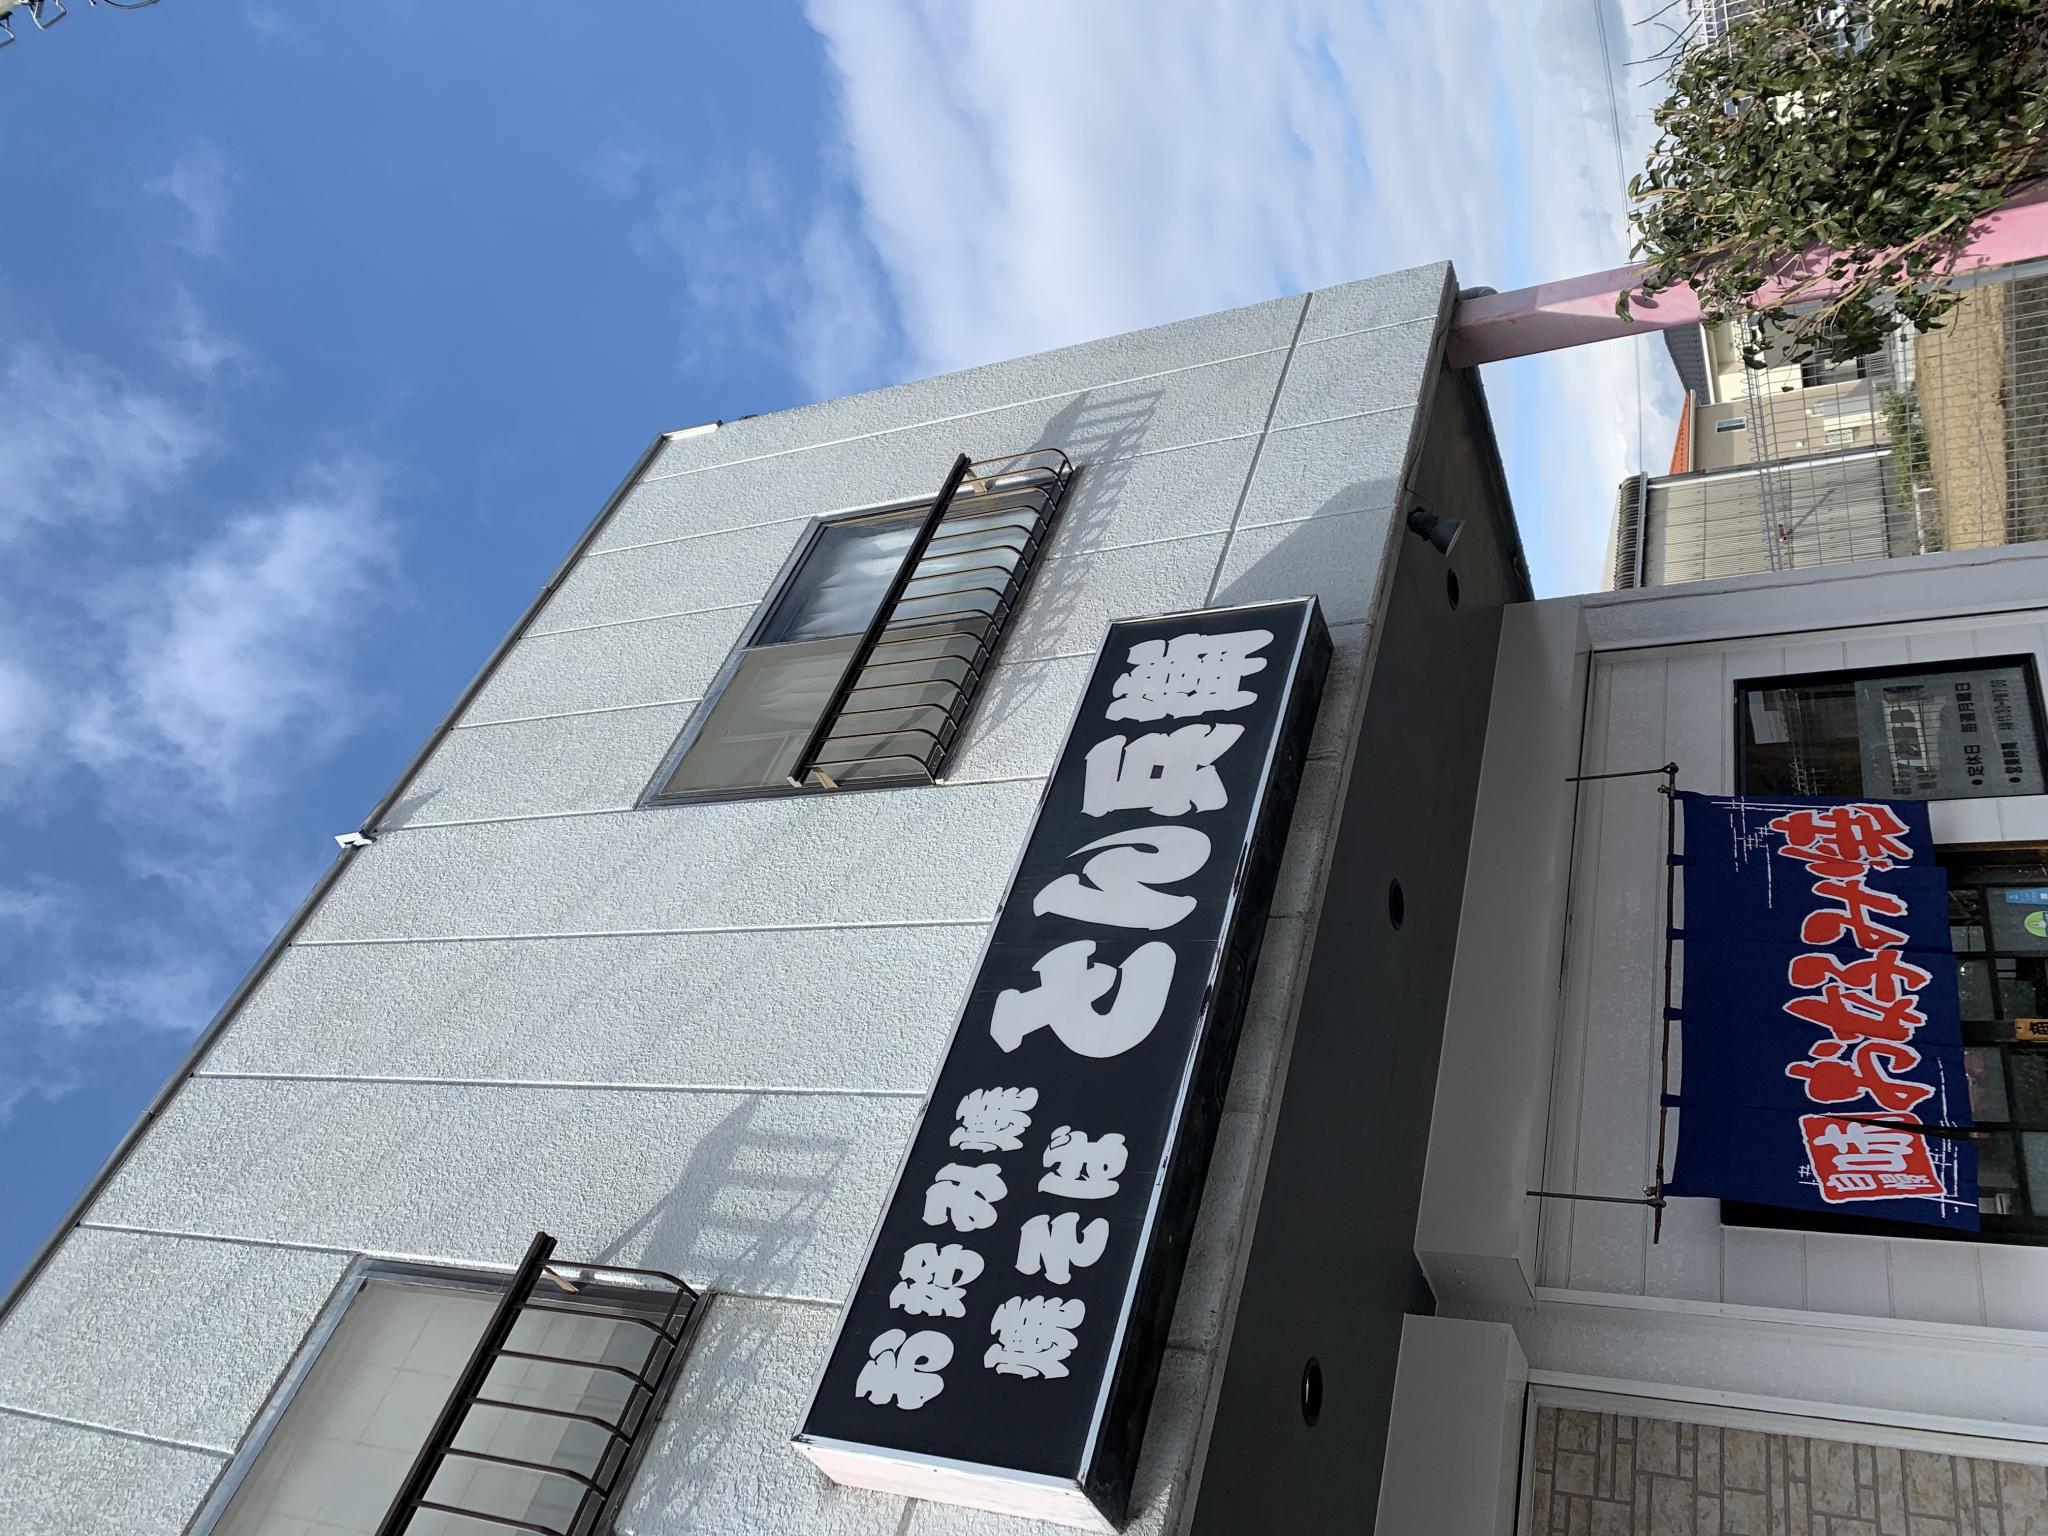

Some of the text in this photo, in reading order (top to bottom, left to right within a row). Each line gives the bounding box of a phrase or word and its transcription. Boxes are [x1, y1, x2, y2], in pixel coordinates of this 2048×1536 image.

[989, 629, 1275, 1059] とん兵衛
[1963, 744, 1985, 777] 定休日
[2000, 741, 2023, 775] 営業時間
[1769, 804, 1936, 1112] お好み焼
[855, 1086, 1039, 1410] お好み焼
[983, 1125, 1129, 1380] 焼そば
